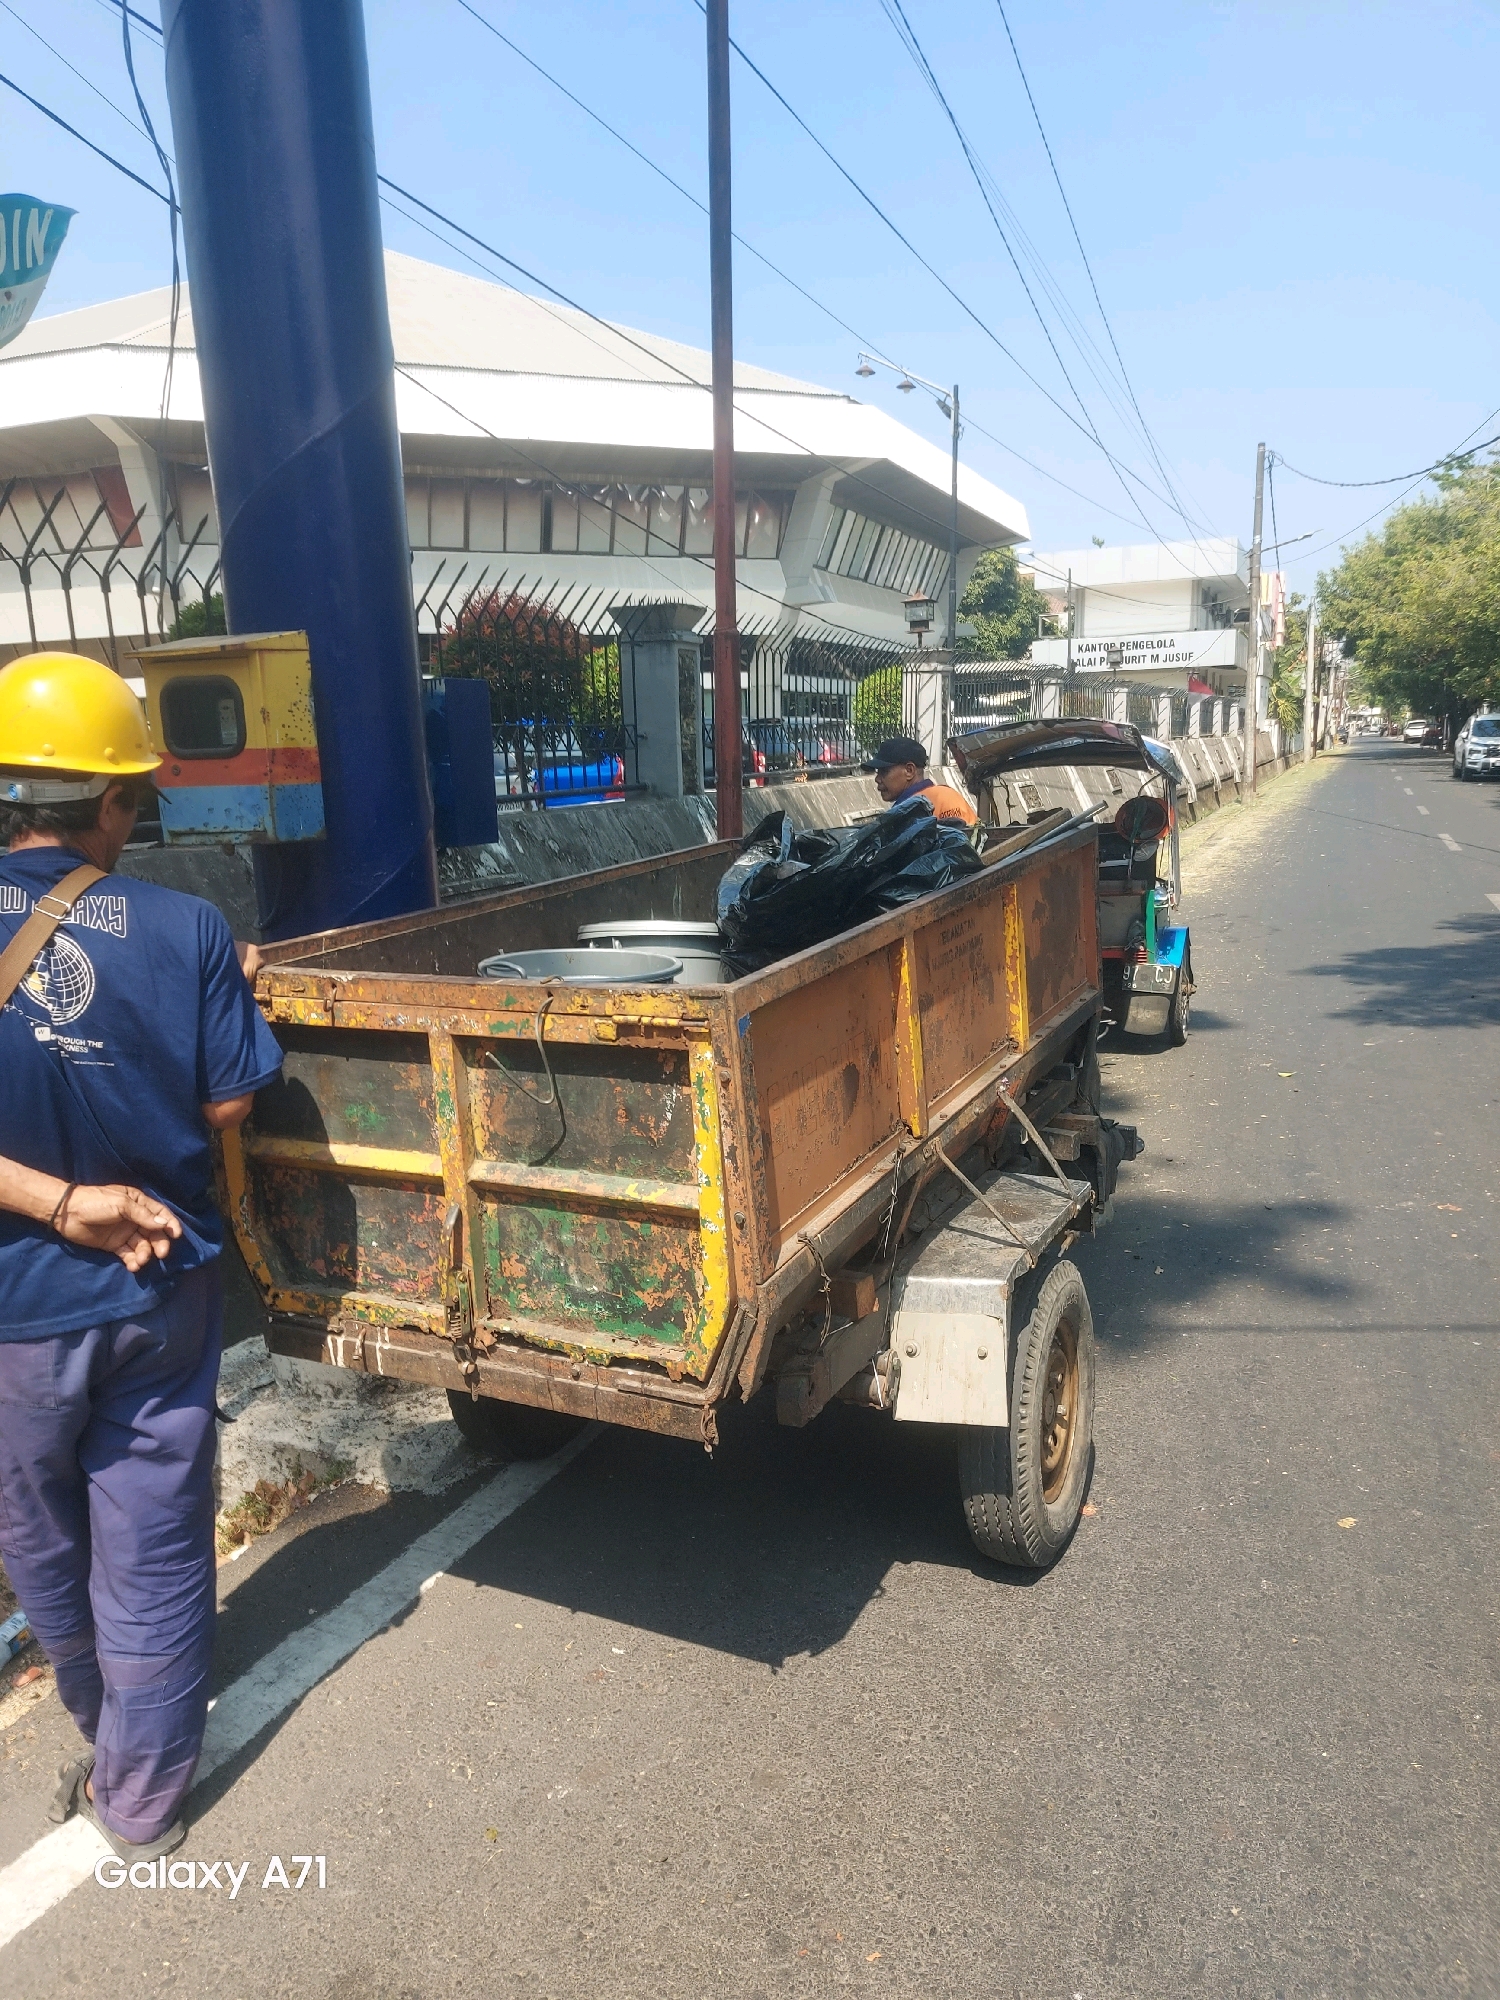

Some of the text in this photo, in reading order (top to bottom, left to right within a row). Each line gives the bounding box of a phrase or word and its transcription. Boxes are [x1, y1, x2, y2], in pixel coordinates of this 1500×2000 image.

[1119, 639, 1175, 651] PENGELOLA
[1073, 657, 1096, 667] ALAI
[1151, 654, 1159, 664] M
[1162, 652, 1194, 663] JUSUF
[87, 1040, 104, 1049] THE
